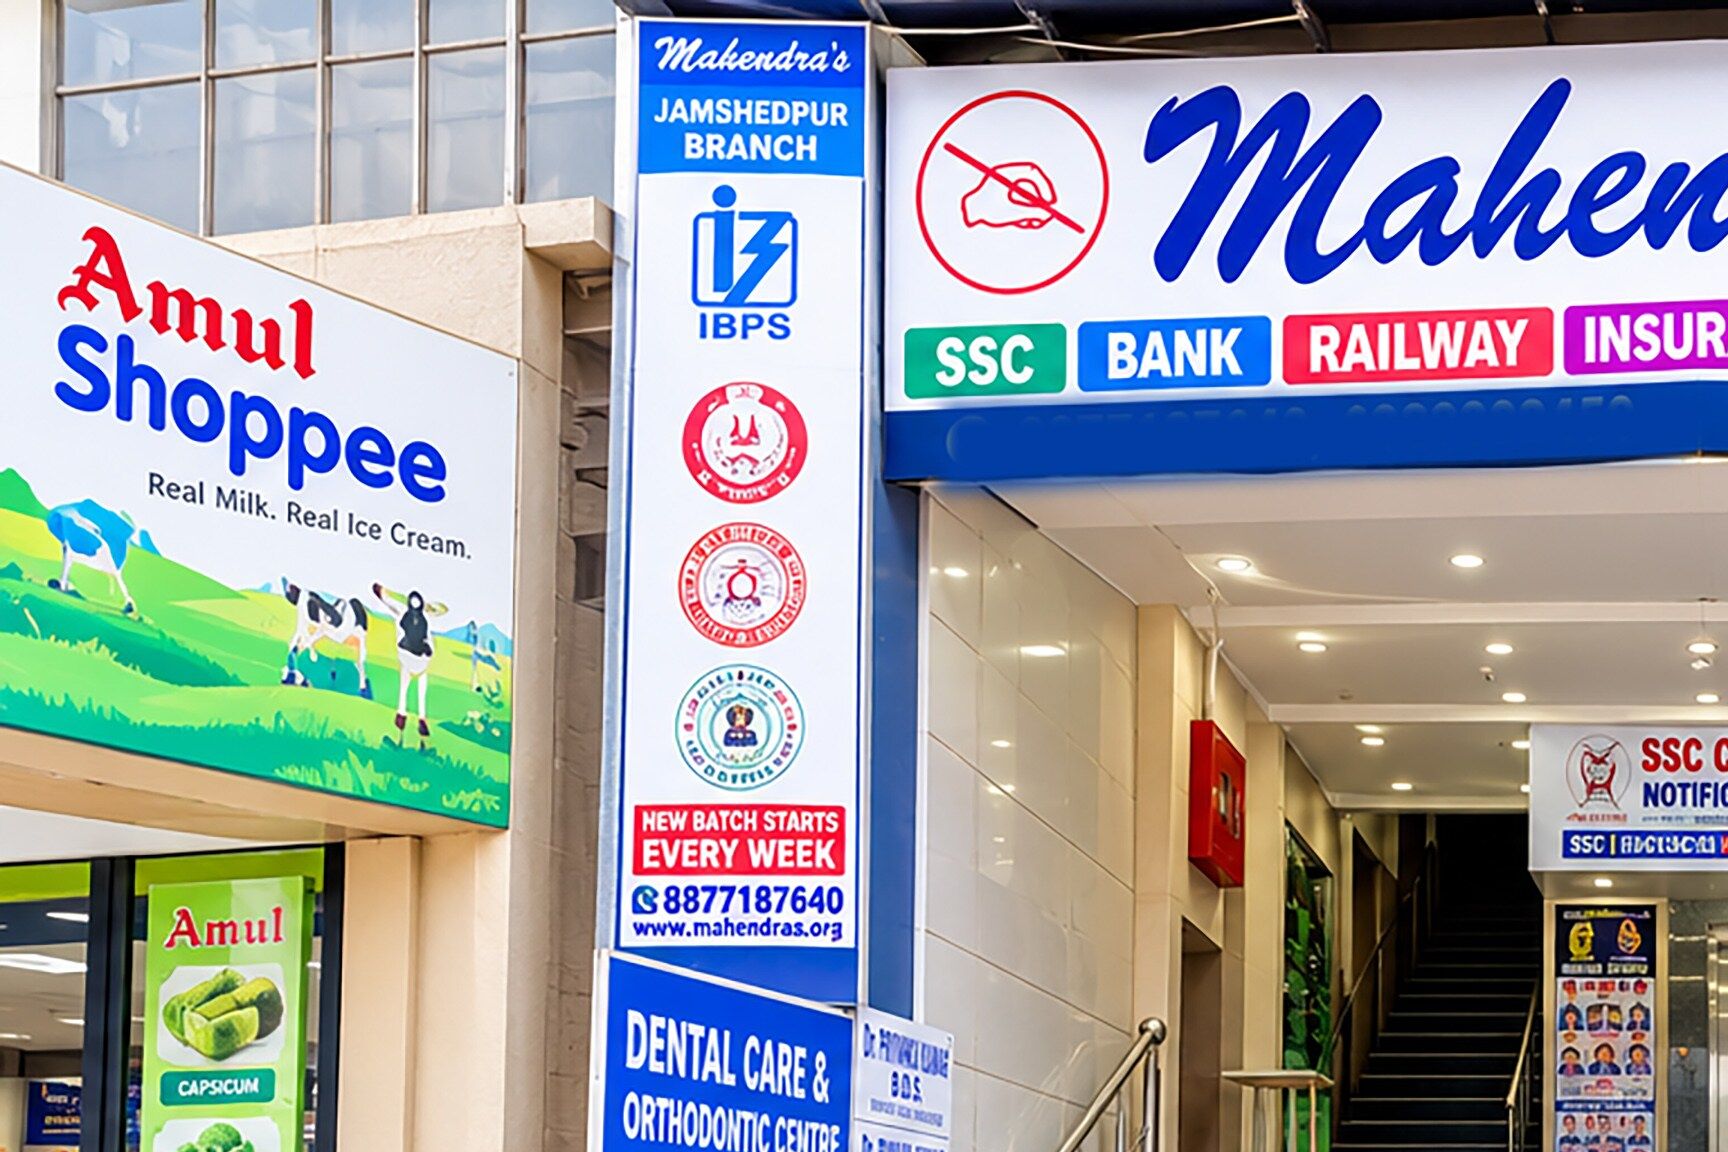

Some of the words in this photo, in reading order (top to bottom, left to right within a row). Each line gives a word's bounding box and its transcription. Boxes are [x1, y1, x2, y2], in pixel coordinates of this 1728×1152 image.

[654, 98, 849, 126] JAMSHEDPUR
[684, 133, 818, 161] BRANCH
[57, 226, 316, 379] Amul
[699, 313, 791, 340] IBPS
[935, 334, 1035, 388] SSC
[1107, 326, 1243, 380] BANK
[1309, 318, 1528, 373] RAILWAY
[54, 323, 447, 503] Shoppee
[148, 472, 204, 504] Real
[215, 483, 276, 520] Milk.
[287, 501, 338, 531] Real
[347, 512, 382, 541] Ice
[390, 522, 472, 560] Cream.
[1641, 737, 1704, 773] SSC
[692, 811, 757, 832] BATCH
[762, 811, 839, 832] STARTS
[642, 839, 740, 869] EVERY
[747, 839, 837, 869] WEEK
[1570, 835, 1605, 854] SSC
[663, 885, 844, 915] 8877187640
[164, 906, 285, 949] Amul
[625, 1008, 737, 1087] DENTAL
[743, 1034, 806, 1101] CARE
[813, 1050, 830, 1104] &
[178, 1077, 260, 1097] CAPSICUM
